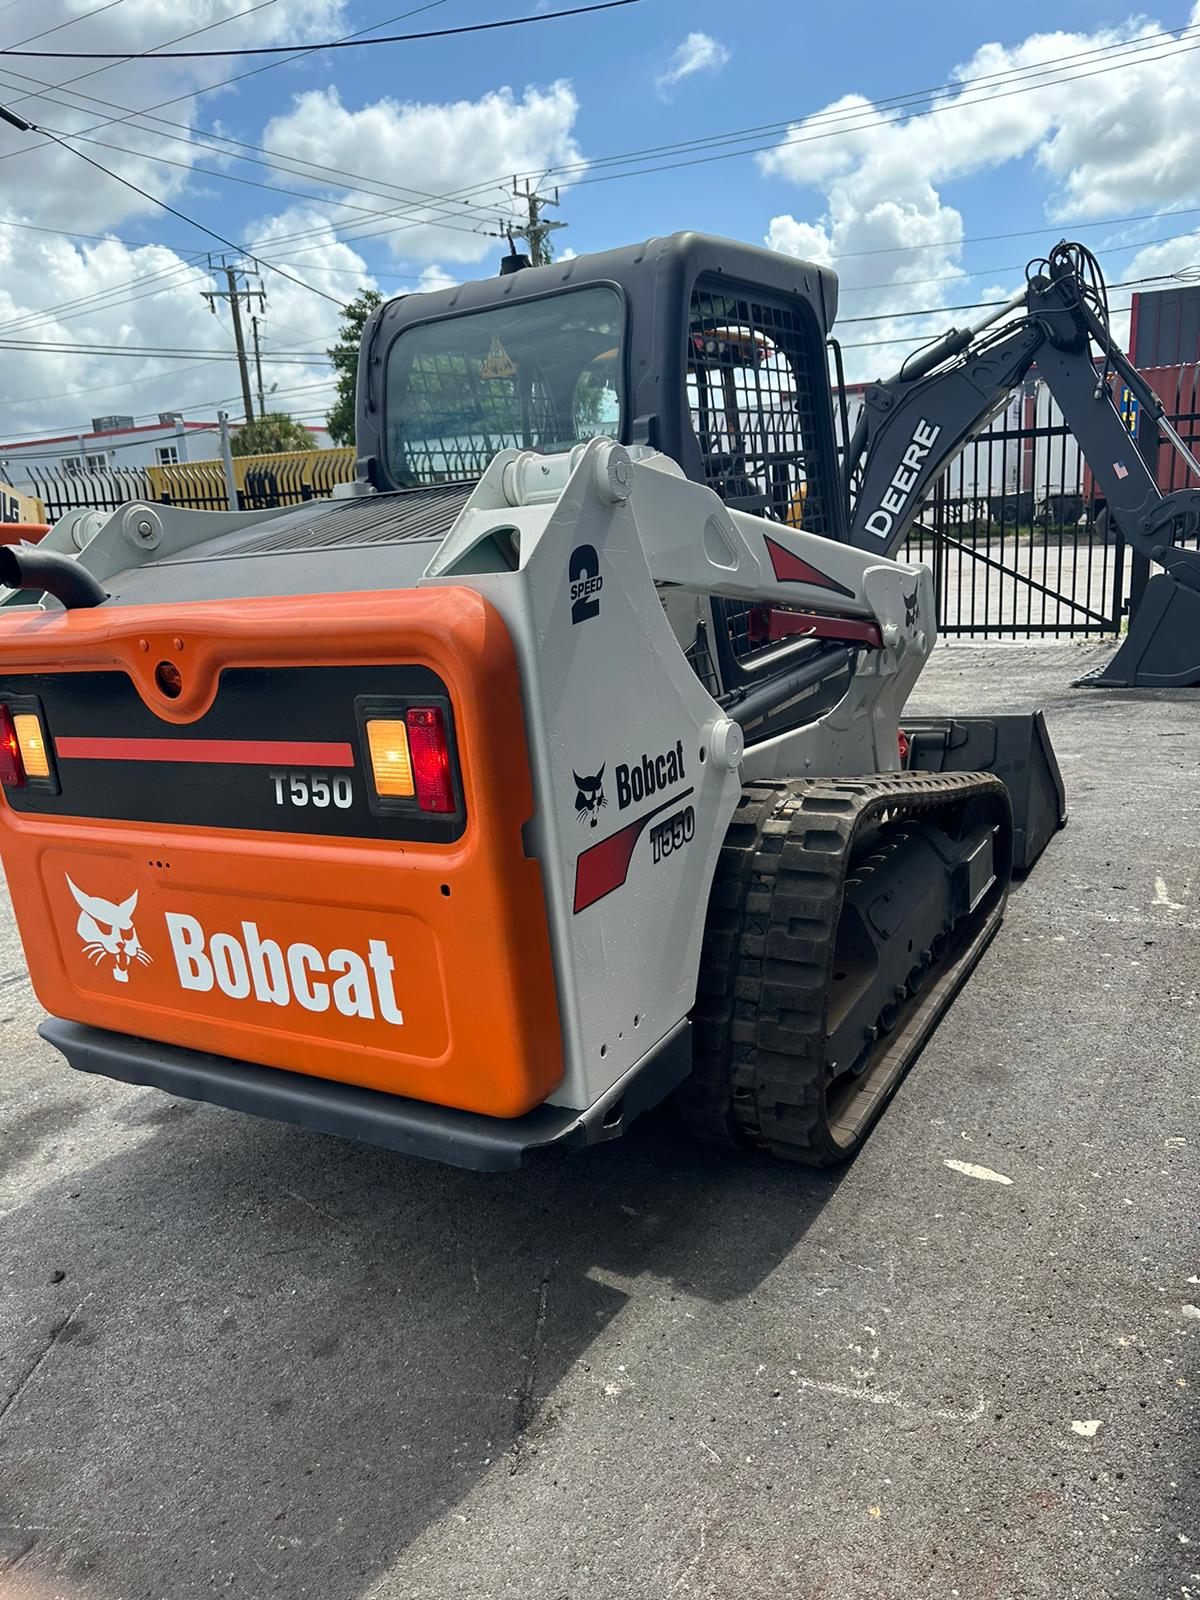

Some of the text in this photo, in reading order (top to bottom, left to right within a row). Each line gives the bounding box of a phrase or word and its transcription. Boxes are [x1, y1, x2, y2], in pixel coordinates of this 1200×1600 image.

[864, 418, 941, 539] DEERE
[569, 544, 603, 625] 2 SPEED
[268, 771, 354, 809] T550
[615, 739, 685, 811] Bobcat
[649, 805, 696, 865] T550
[164, 911, 404, 1025] Bobcat
